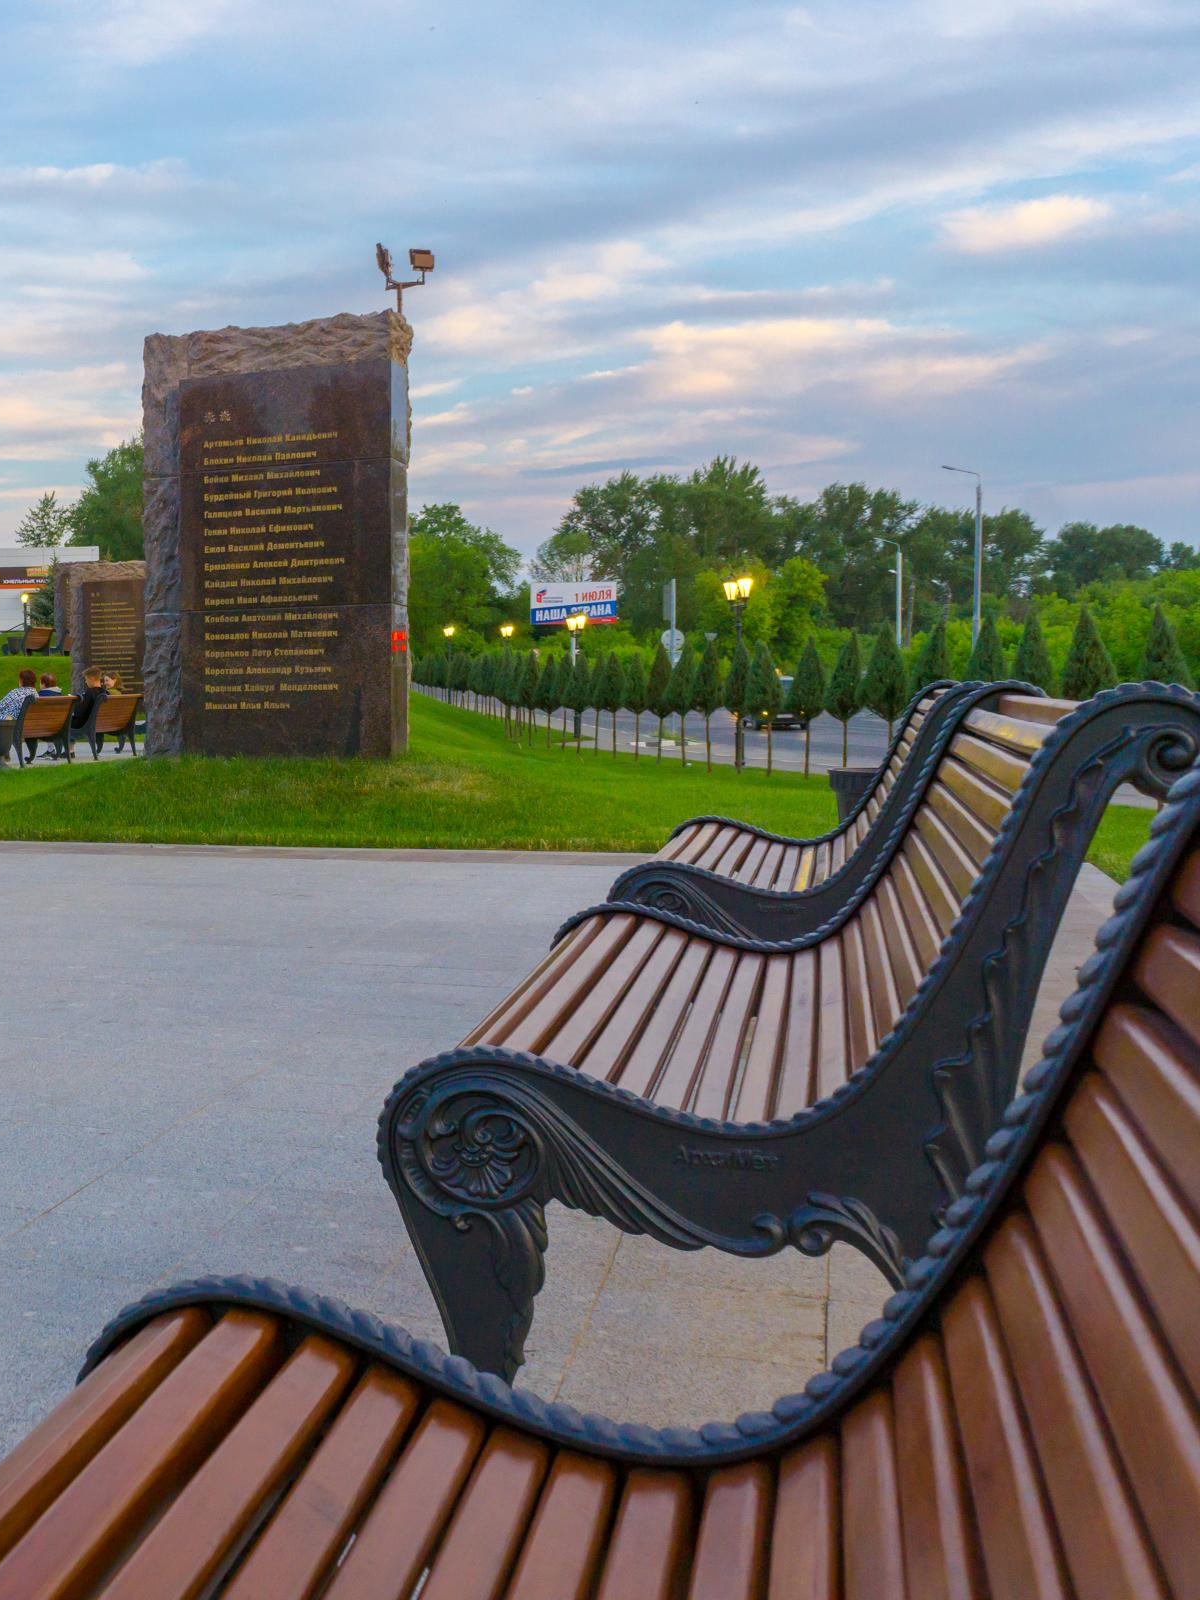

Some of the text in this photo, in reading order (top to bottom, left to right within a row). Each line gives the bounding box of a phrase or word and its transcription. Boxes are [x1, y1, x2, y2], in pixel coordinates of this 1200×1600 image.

[247, 435, 283, 445] Николай
[237, 455, 272, 463] Николай
[275, 451, 316, 460] Павлович
[232, 472, 264, 481] Михаил
[266, 469, 320, 479] Михайлович
[254, 488, 292, 499] Григорий
[296, 486, 337, 495] Иванович
[245, 506, 281, 516] Василий
[230, 525, 266, 534] Николай
[269, 523, 314, 534] Ефимович
[228, 543, 264, 552] Василий
[266, 541, 324, 551] Дементьевич
[253, 559, 288, 568] Алексей
[291, 557, 344, 568] Дмитриевич
[240, 577, 276, 586] Николай
[279, 576, 333, 585] Михайлович
[237, 596, 257, 604] Иван
[260, 595, 318, 604] Афанасьевич
[575, 591, 579, 603] 1
[581, 589, 612, 602] ИЮЛЯ
[242, 614, 282, 622] Анатолий
[285, 612, 338, 620] Михайлович
[536, 603, 612, 621] НАША СТРАНА
[252, 631, 288, 639] Николай
[291, 630, 338, 638] Матвеевич
[274, 648, 324, 656] Степанович
[246, 666, 292, 675] Александр
[295, 665, 331, 674] Кузьмич
